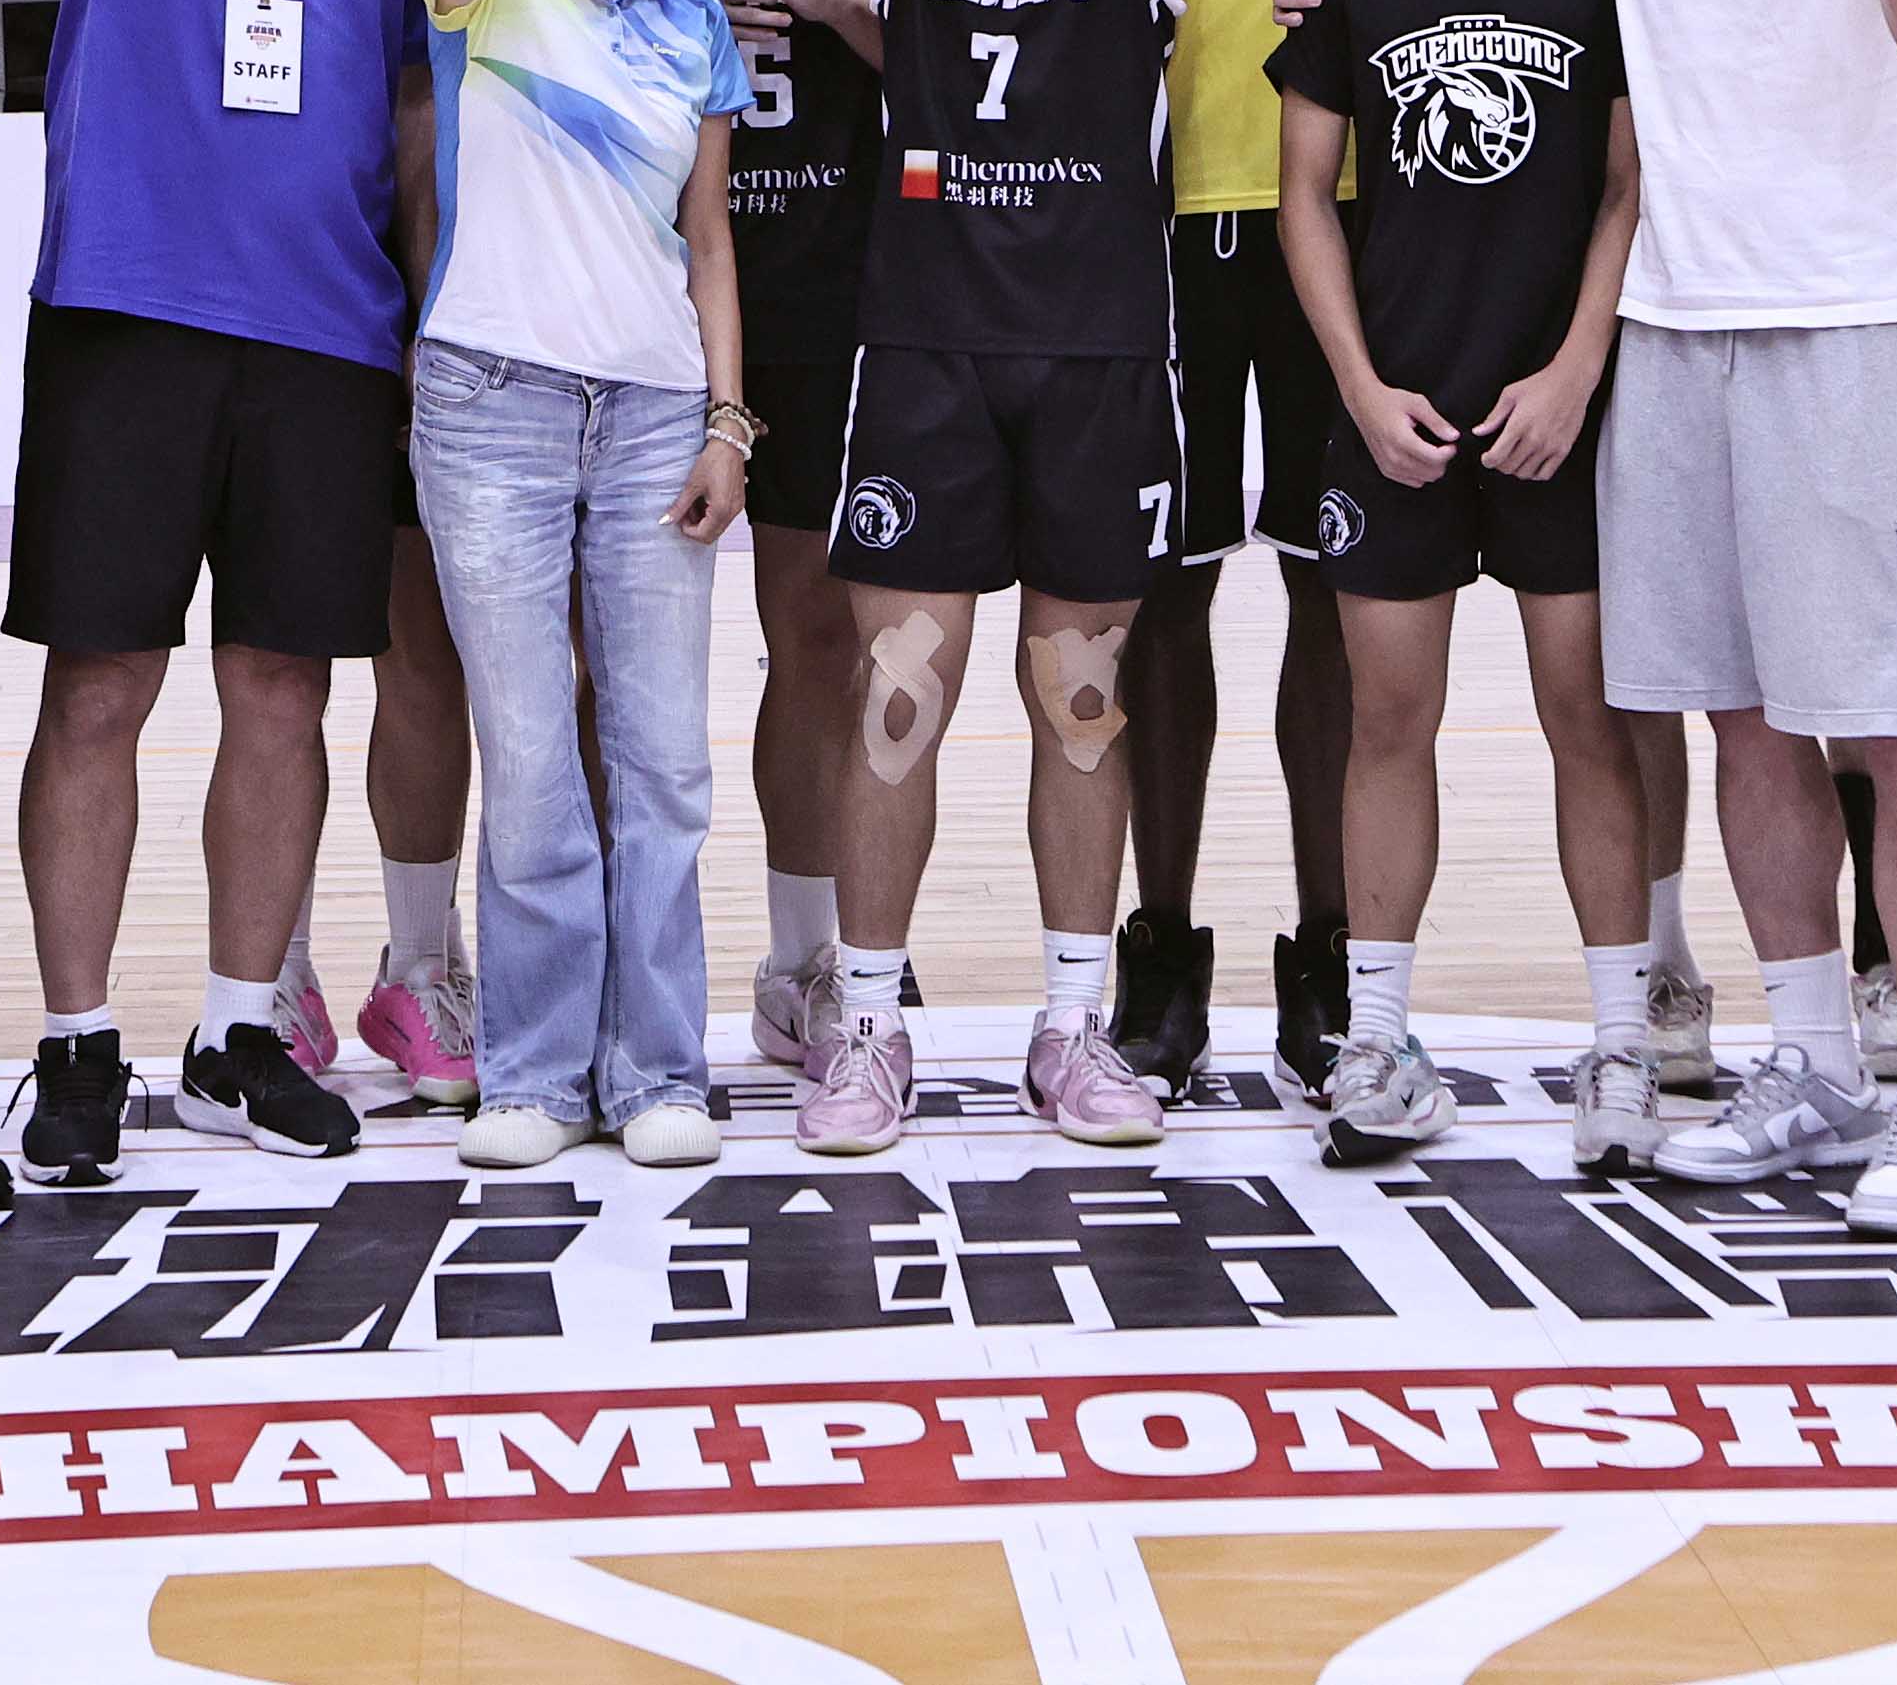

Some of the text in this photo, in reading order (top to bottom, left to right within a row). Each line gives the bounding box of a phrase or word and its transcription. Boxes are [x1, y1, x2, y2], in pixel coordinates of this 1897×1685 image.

[233, 61, 292, 81] STAFF
[731, 36, 794, 128] 5
[970, 32, 1019, 121] 7
[728, 163, 846, 191] ermoVe
[946, 151, 1102, 184] ThermoVex
[1138, 480, 1172, 559] 7
